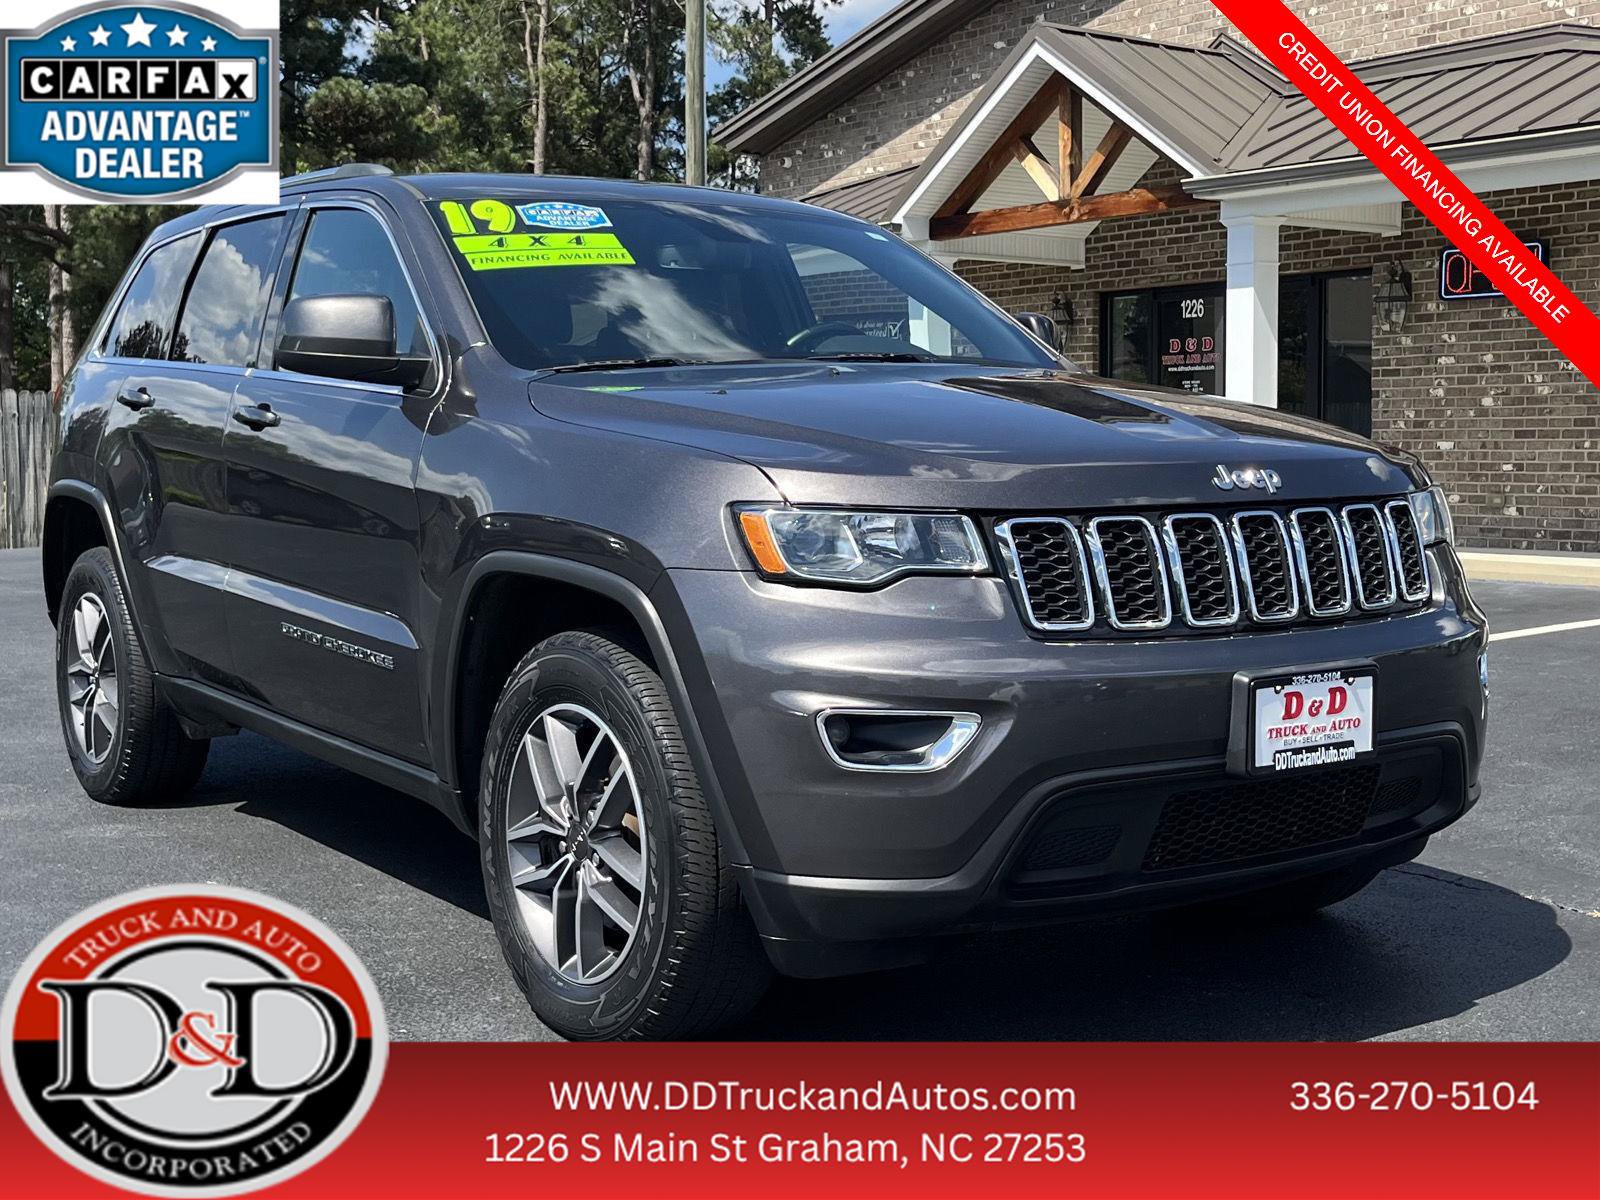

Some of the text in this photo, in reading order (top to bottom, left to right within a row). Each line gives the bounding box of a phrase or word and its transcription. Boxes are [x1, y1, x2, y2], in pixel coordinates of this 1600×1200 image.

[439, 200, 516, 235] 19
[488, 235, 587, 248] 4 X 4
[471, 252, 627, 265] FINANCING AVAILABLE
[1181, 299, 1204, 318] 1226
[1169, 337, 1213, 353] D & D
[1212, 464, 1282, 494] Jeep
[1292, 671, 1341, 686] 336-270-5104
[1282, 686, 1348, 720] D & D
[1268, 718, 1361, 739] TRUCK AND AUTO
[1283, 732, 1344, 747] BUY SELL TRADE
[1275, 746, 1356, 770] DDTruckandAuto.com
